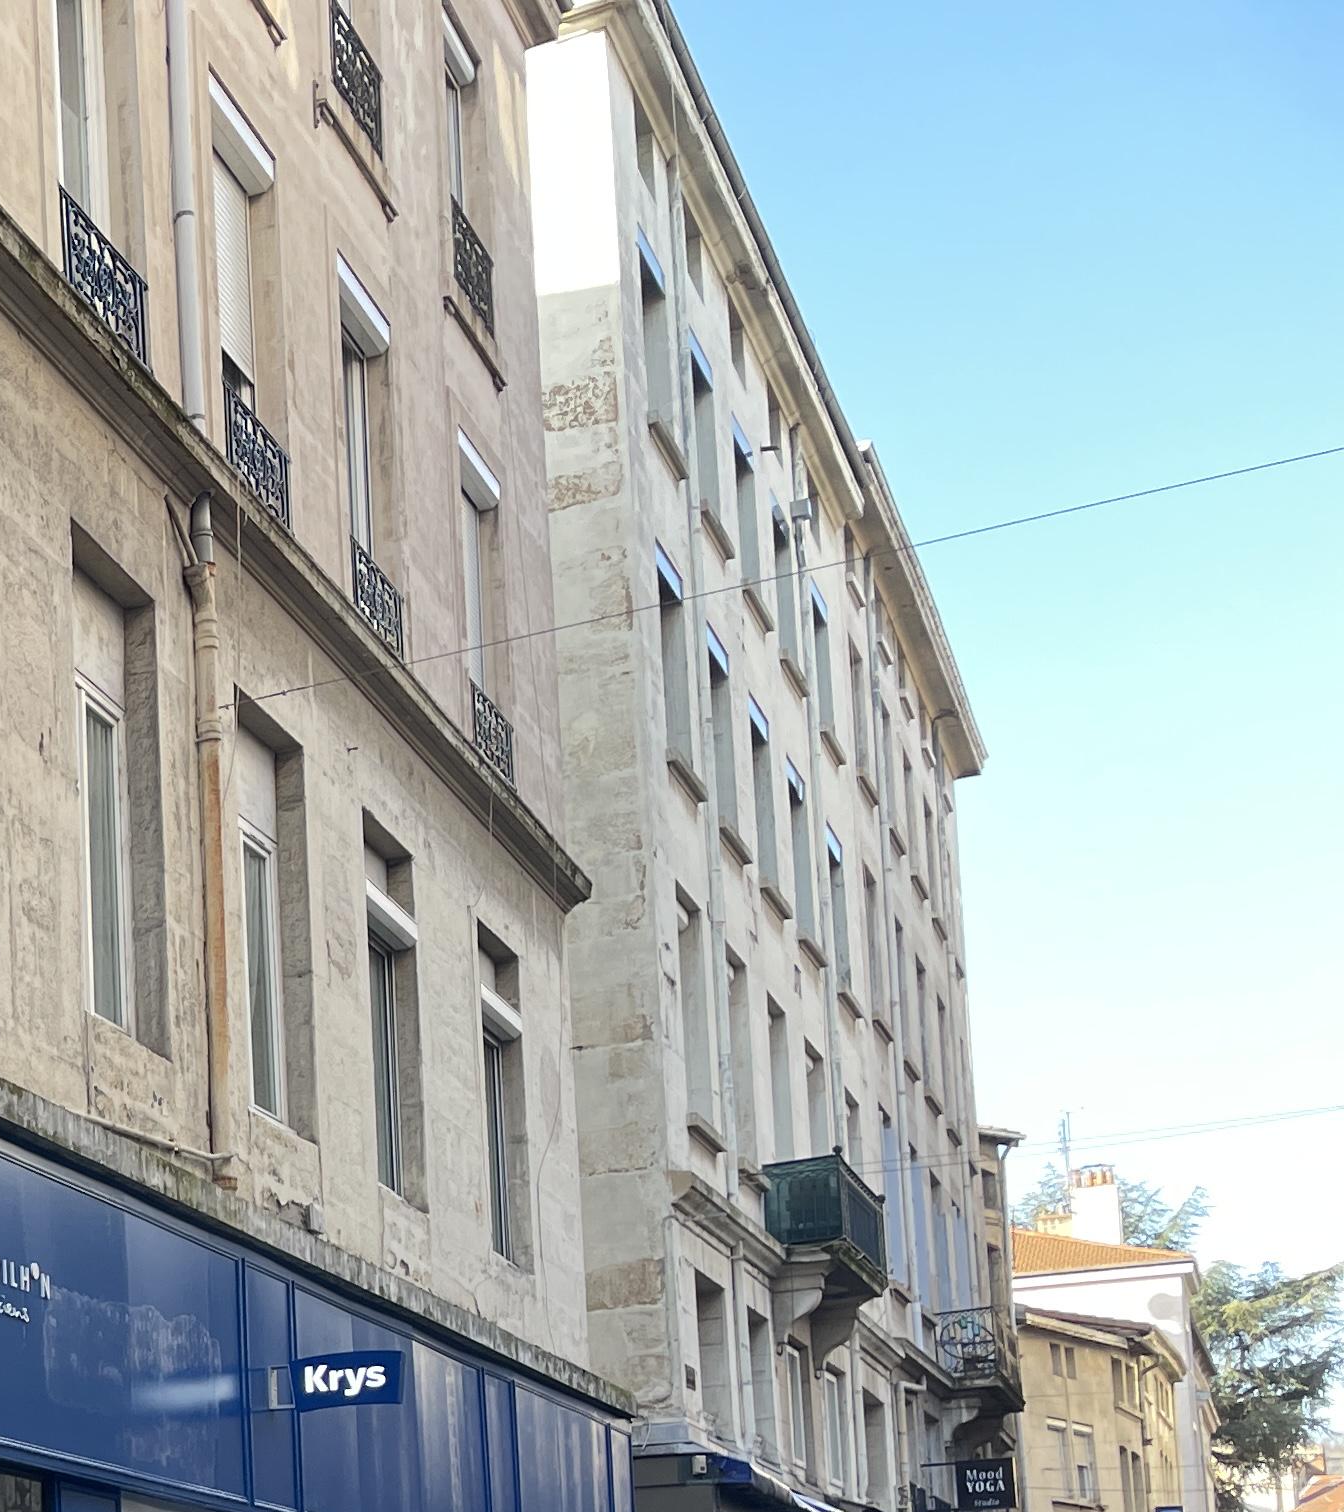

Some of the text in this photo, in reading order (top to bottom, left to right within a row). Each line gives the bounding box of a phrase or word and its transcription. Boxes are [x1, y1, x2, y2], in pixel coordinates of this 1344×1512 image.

[303, 1363, 387, 1397] Krys
[965, 1466, 1004, 1481] Mood
[966, 1479, 1005, 1493] YOGA
